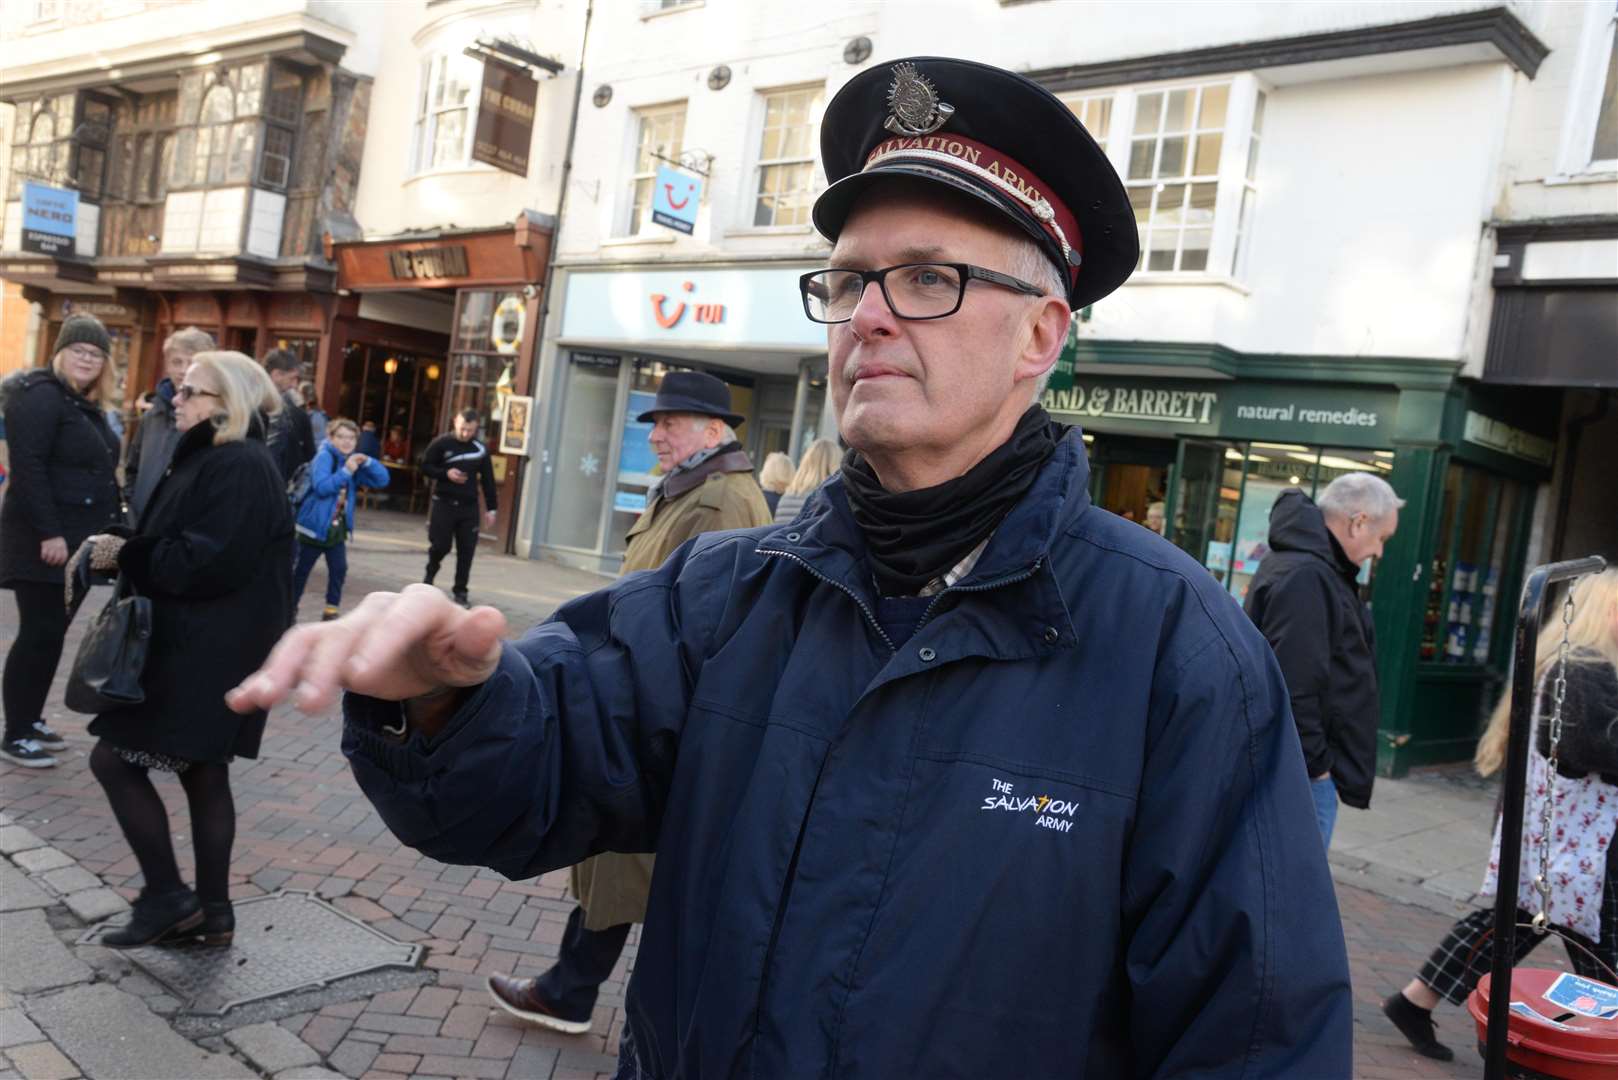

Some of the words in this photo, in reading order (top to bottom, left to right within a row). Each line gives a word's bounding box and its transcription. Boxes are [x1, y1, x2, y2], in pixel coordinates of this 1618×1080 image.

[26, 207, 74, 224] NERO
[1087, 386, 1111, 416] &
[1111, 388, 1217, 424] BARRETT
[1236, 404, 1295, 421] natural
[1298, 407, 1378, 427] remedies
[992, 778, 1014, 794] THE
[981, 795, 1080, 817] SALVATION
[1035, 815, 1074, 833] ARMY
